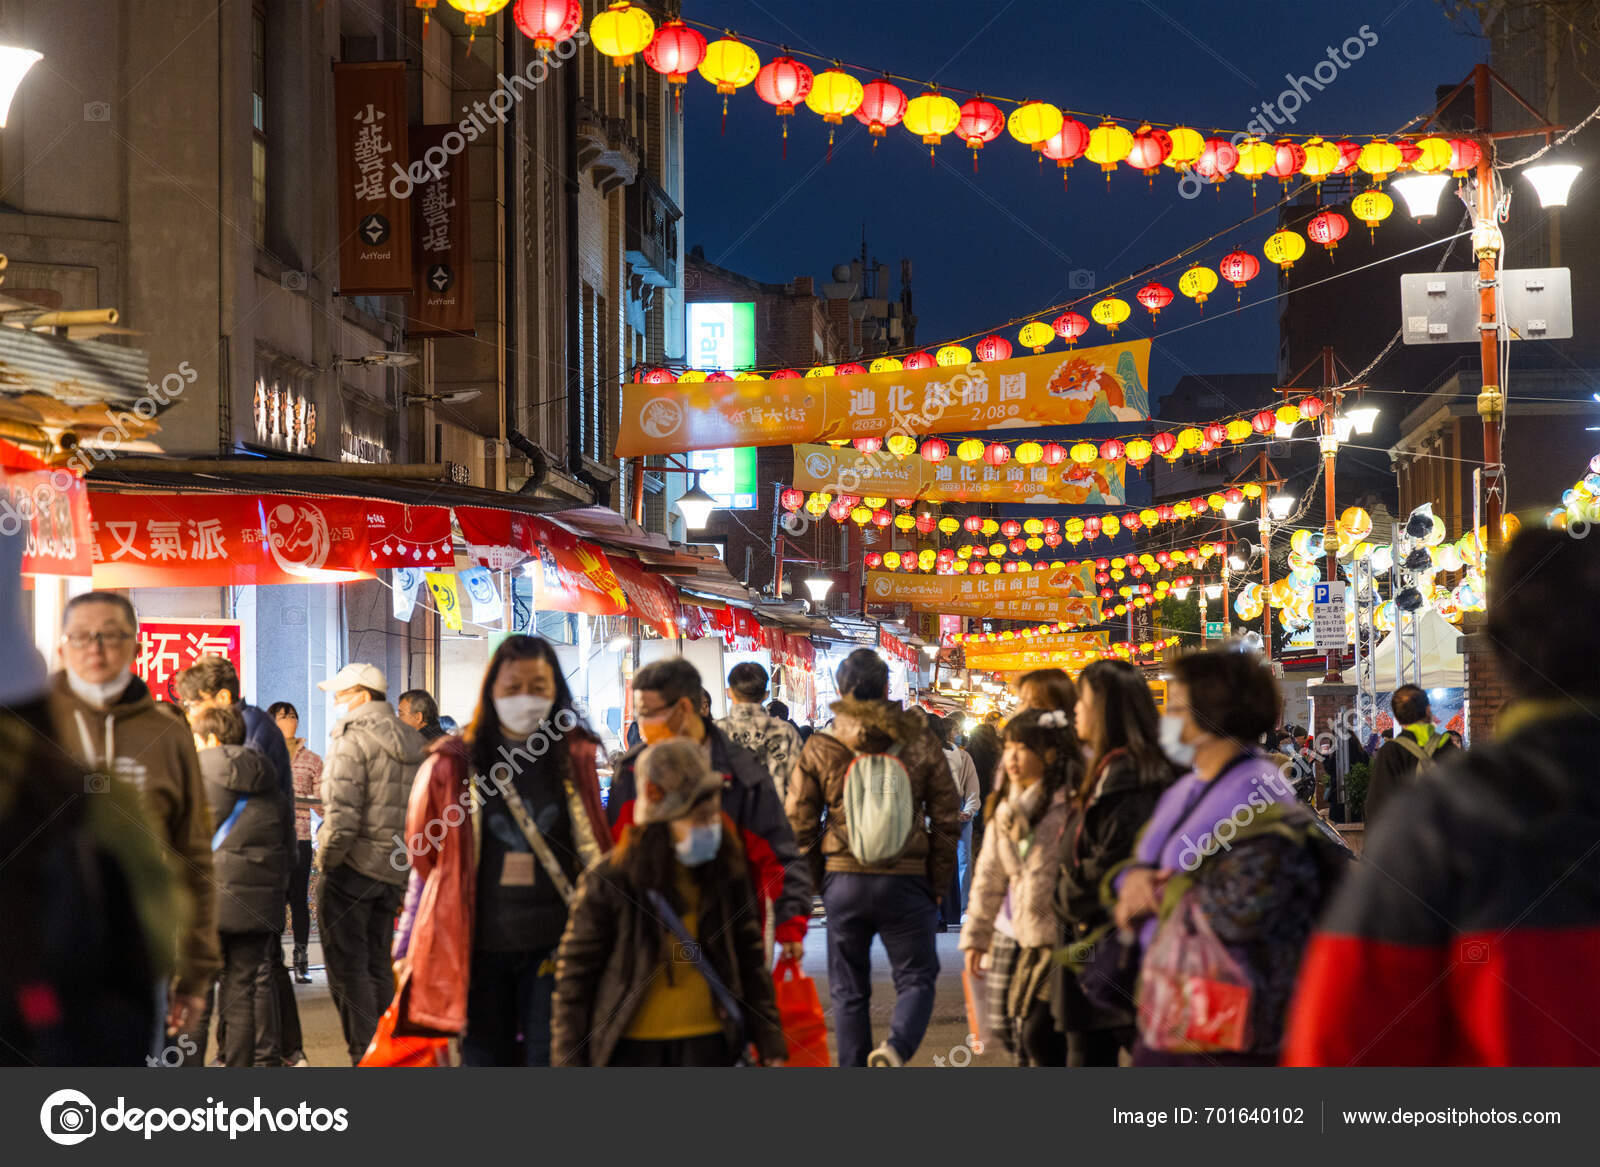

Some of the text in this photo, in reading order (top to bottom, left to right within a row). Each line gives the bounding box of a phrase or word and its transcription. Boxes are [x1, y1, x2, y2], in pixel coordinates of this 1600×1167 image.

[353, 104, 392, 201] 小藝埕
[360, 252, 391, 260] ArtYard
[427, 297, 455, 306] ArtYard
[854, 419, 884, 430] 2024
[330, 527, 355, 542] 公司
[1317, 588, 1327, 601] P
